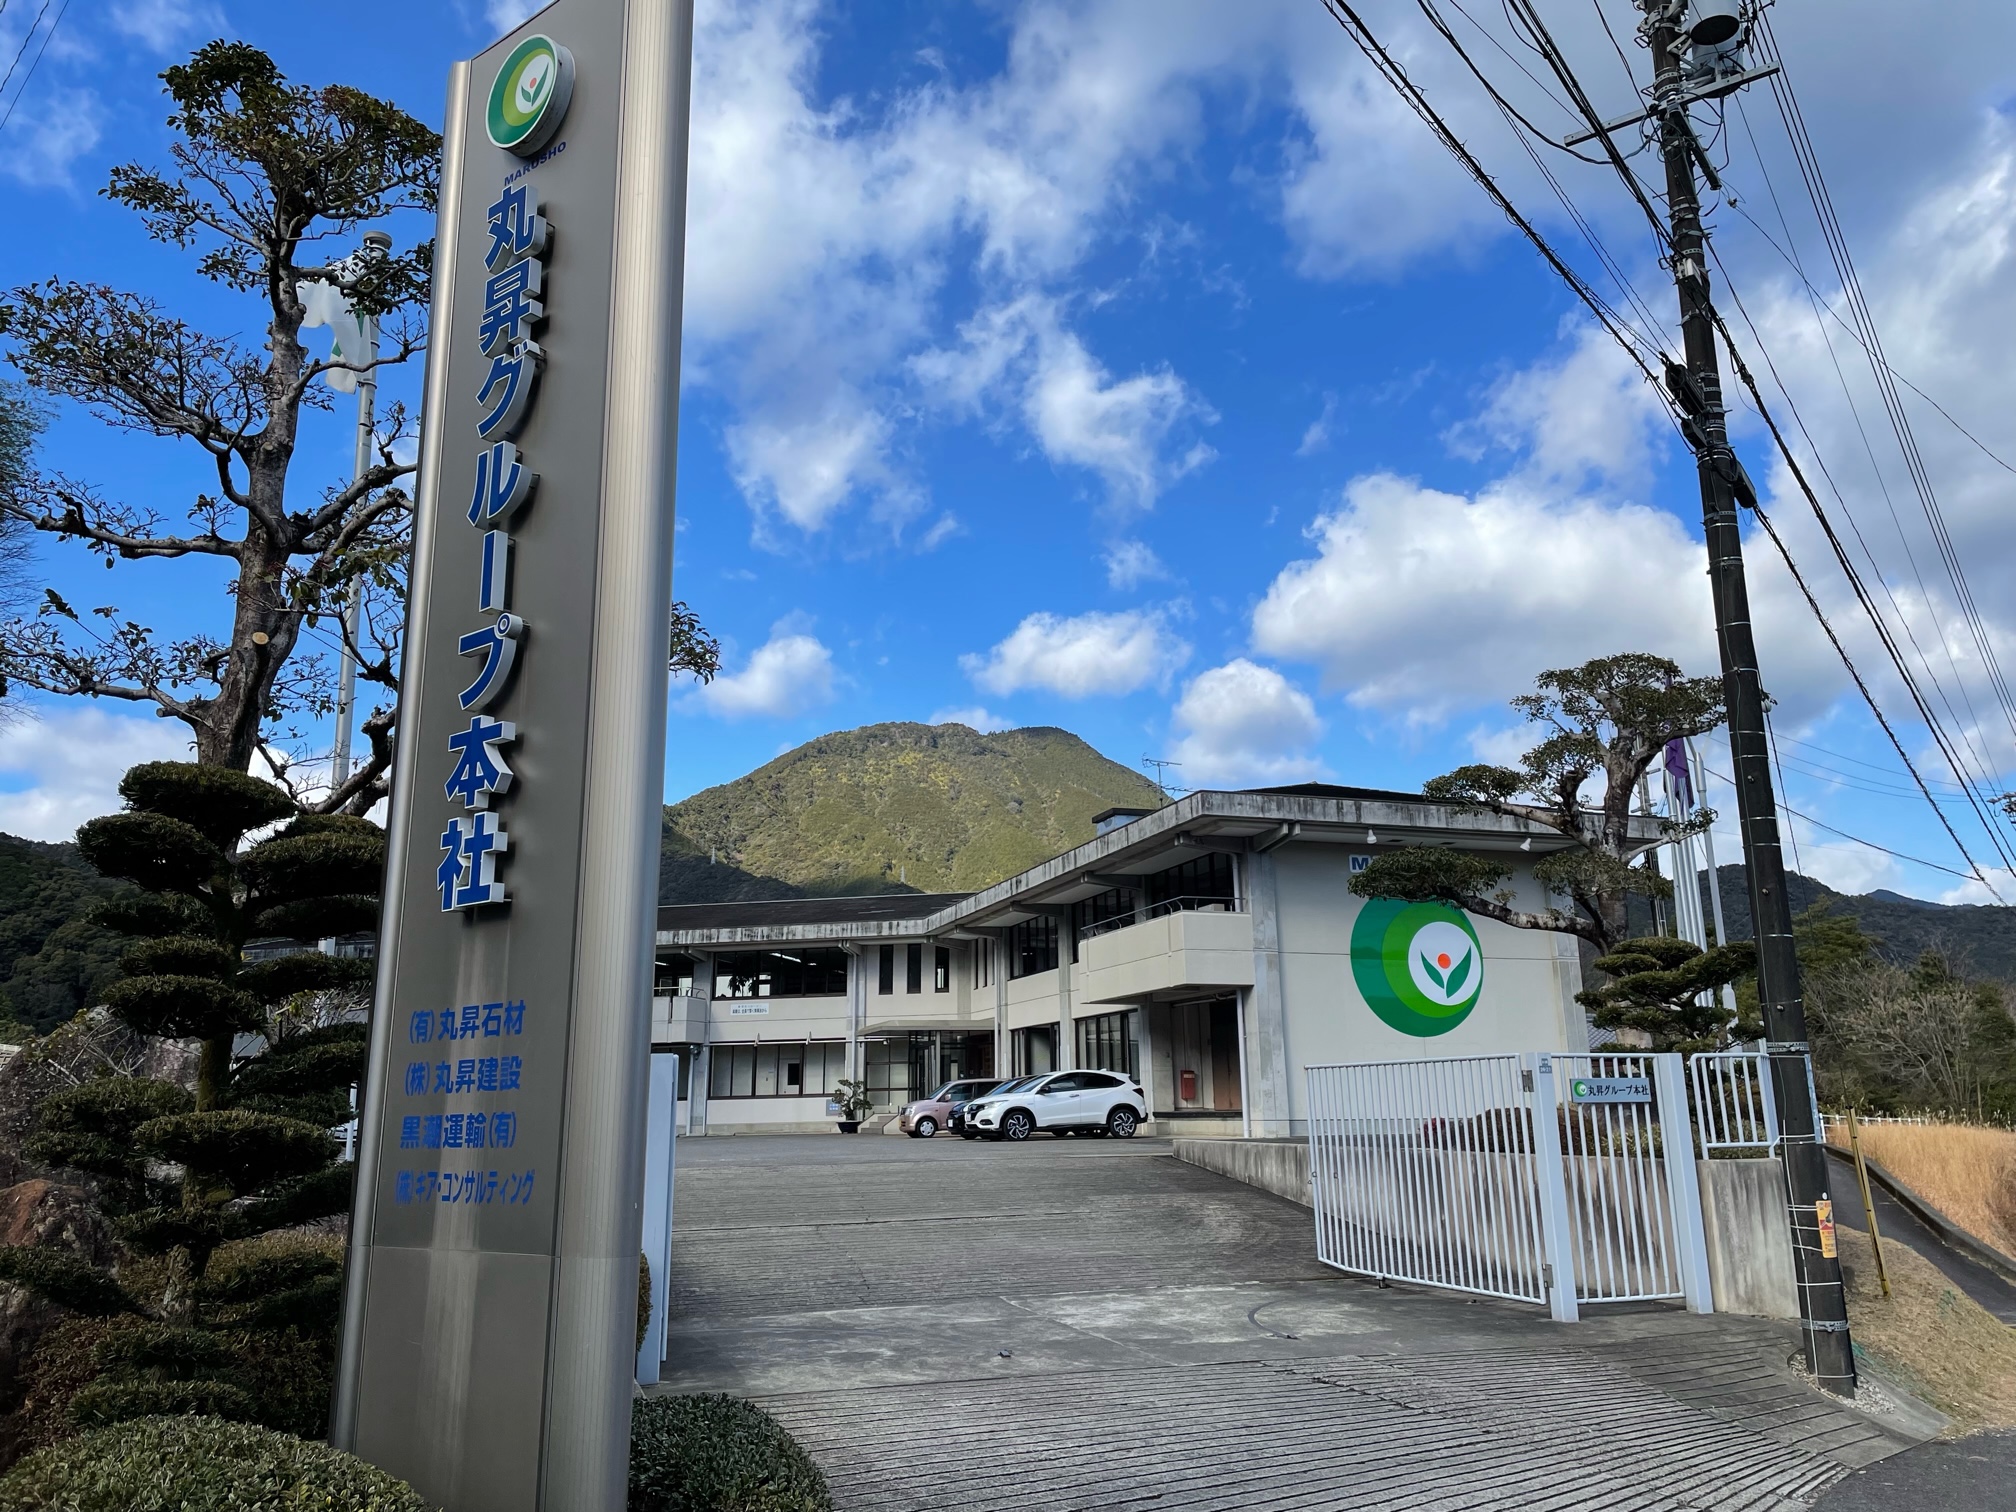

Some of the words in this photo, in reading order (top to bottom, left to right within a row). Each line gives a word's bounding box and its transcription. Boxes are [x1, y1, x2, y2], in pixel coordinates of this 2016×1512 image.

[504, 141, 567, 187] MARUSHO
[437, 183, 545, 913] 丸昇グループ本社
[1587, 1084, 1650, 1097] 丸昇グループ本社
